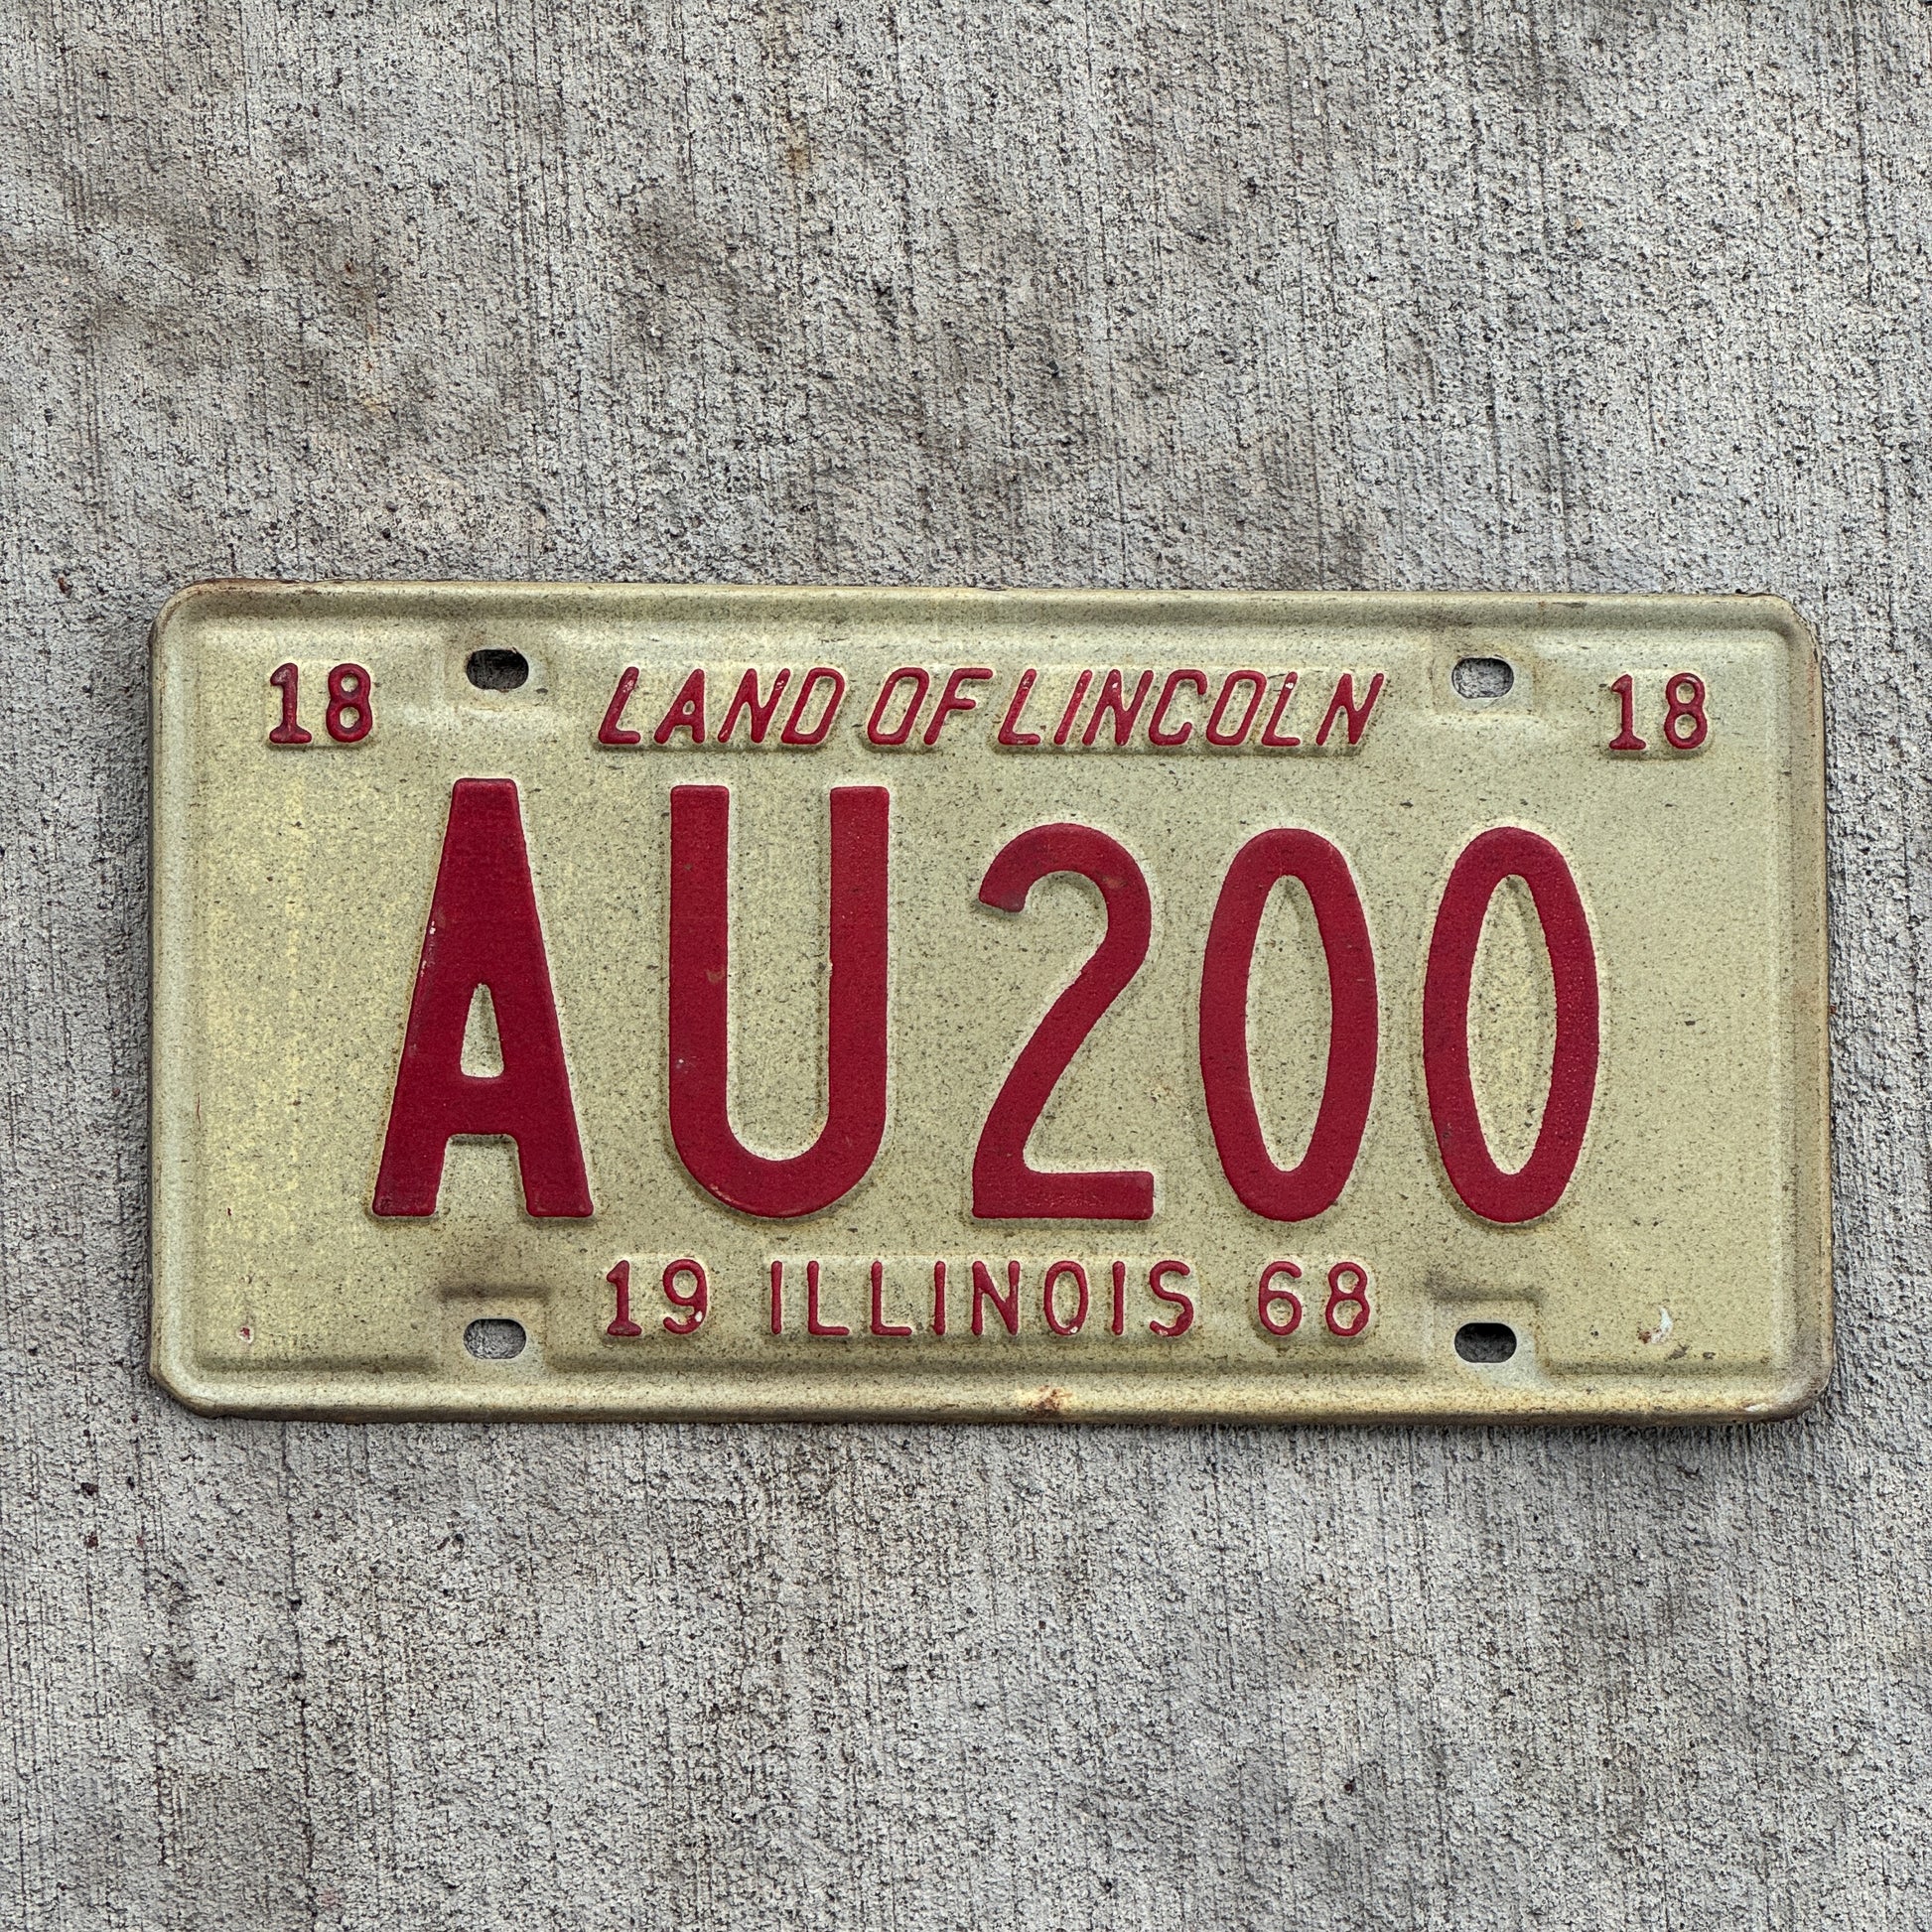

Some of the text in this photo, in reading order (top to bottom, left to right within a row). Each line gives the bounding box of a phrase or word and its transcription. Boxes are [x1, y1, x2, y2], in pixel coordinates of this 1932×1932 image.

[269, 663, 372, 745] 18
[598, 666, 1386, 748] LAND OF LINCOLN
[1608, 672, 1709, 752] 18
[606, 1258, 1372, 1338] 19 ILLINOIS 68
